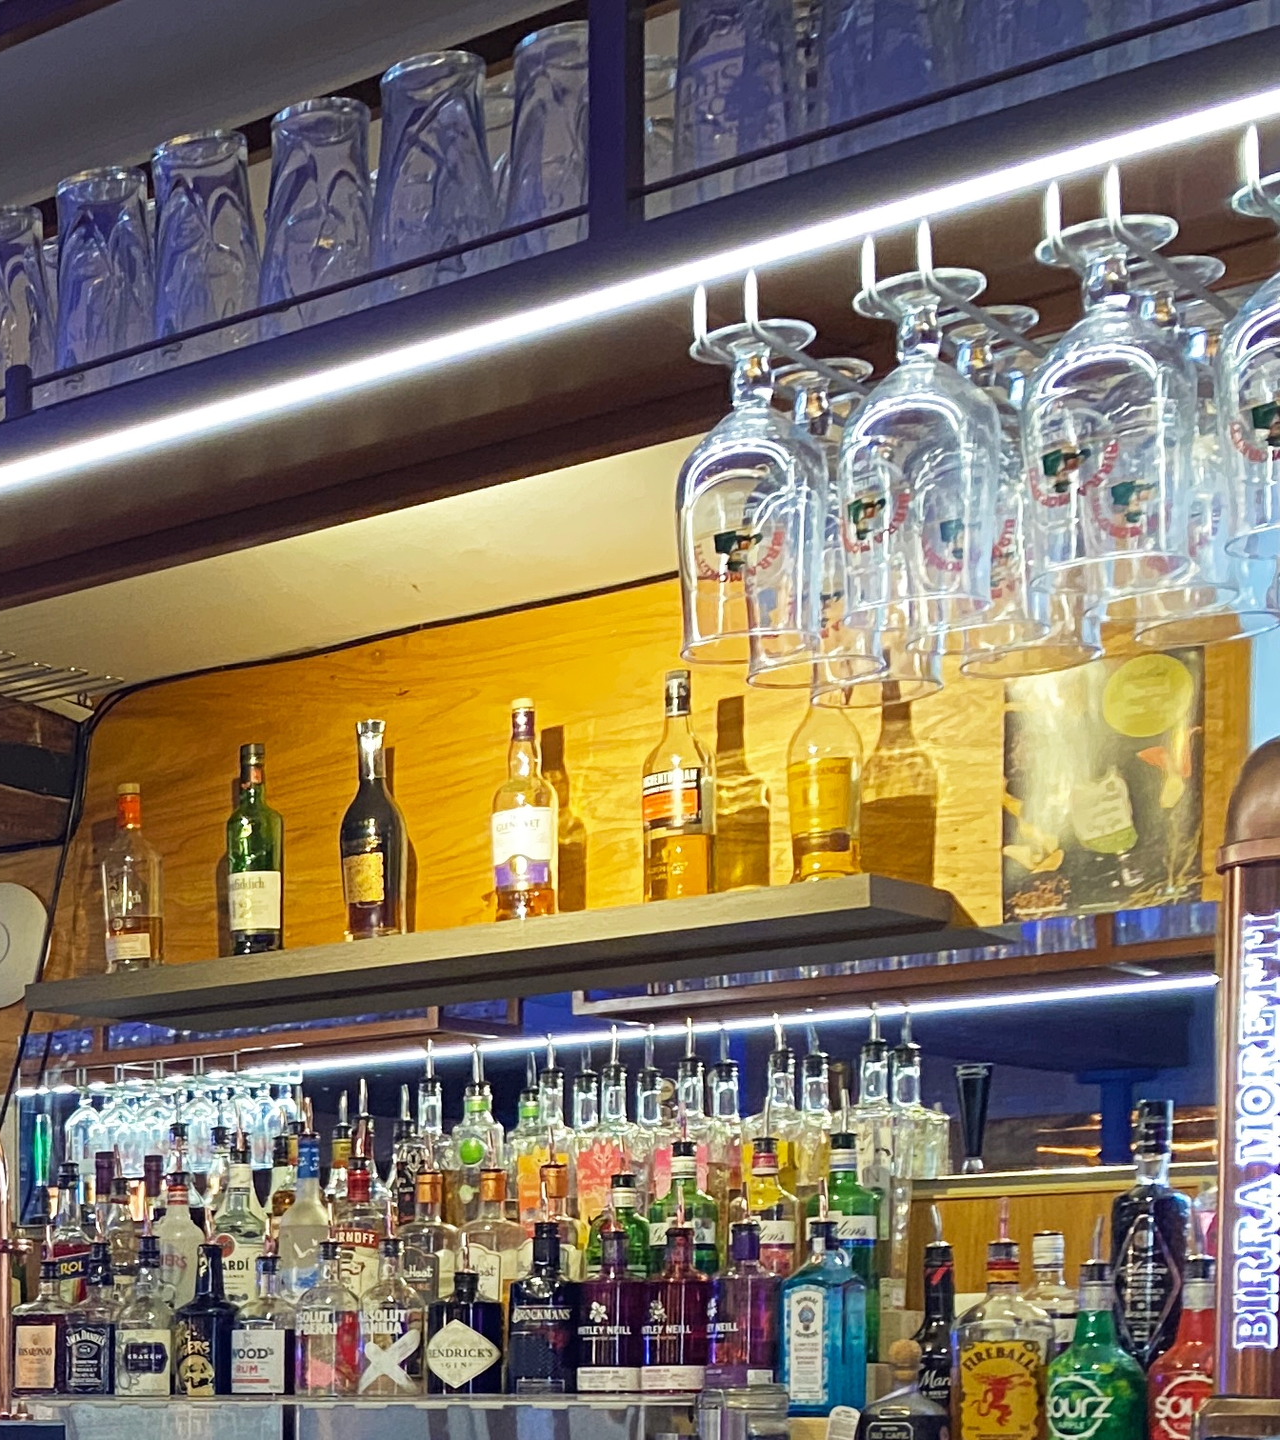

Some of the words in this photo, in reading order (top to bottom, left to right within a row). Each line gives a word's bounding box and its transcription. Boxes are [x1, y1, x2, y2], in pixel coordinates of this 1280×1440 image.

[1233, 1172, 1280, 1350] BIRRA
[60, 1261, 84, 1275] ROL
[512, 1307, 572, 1324] BROCKMANS
[606, 1326, 632, 1335] NEILL
[665, 1324, 692, 1335] NEILL
[715, 1322, 739, 1333] NEILL
[65, 1332, 82, 1347] JACK
[127, 1353, 162, 1361] KRAKEN
[428, 1347, 494, 1360] HENDRICK'S
[962, 1346, 1035, 1372] FIREBALL
[235, 1364, 259, 1374] RUM
